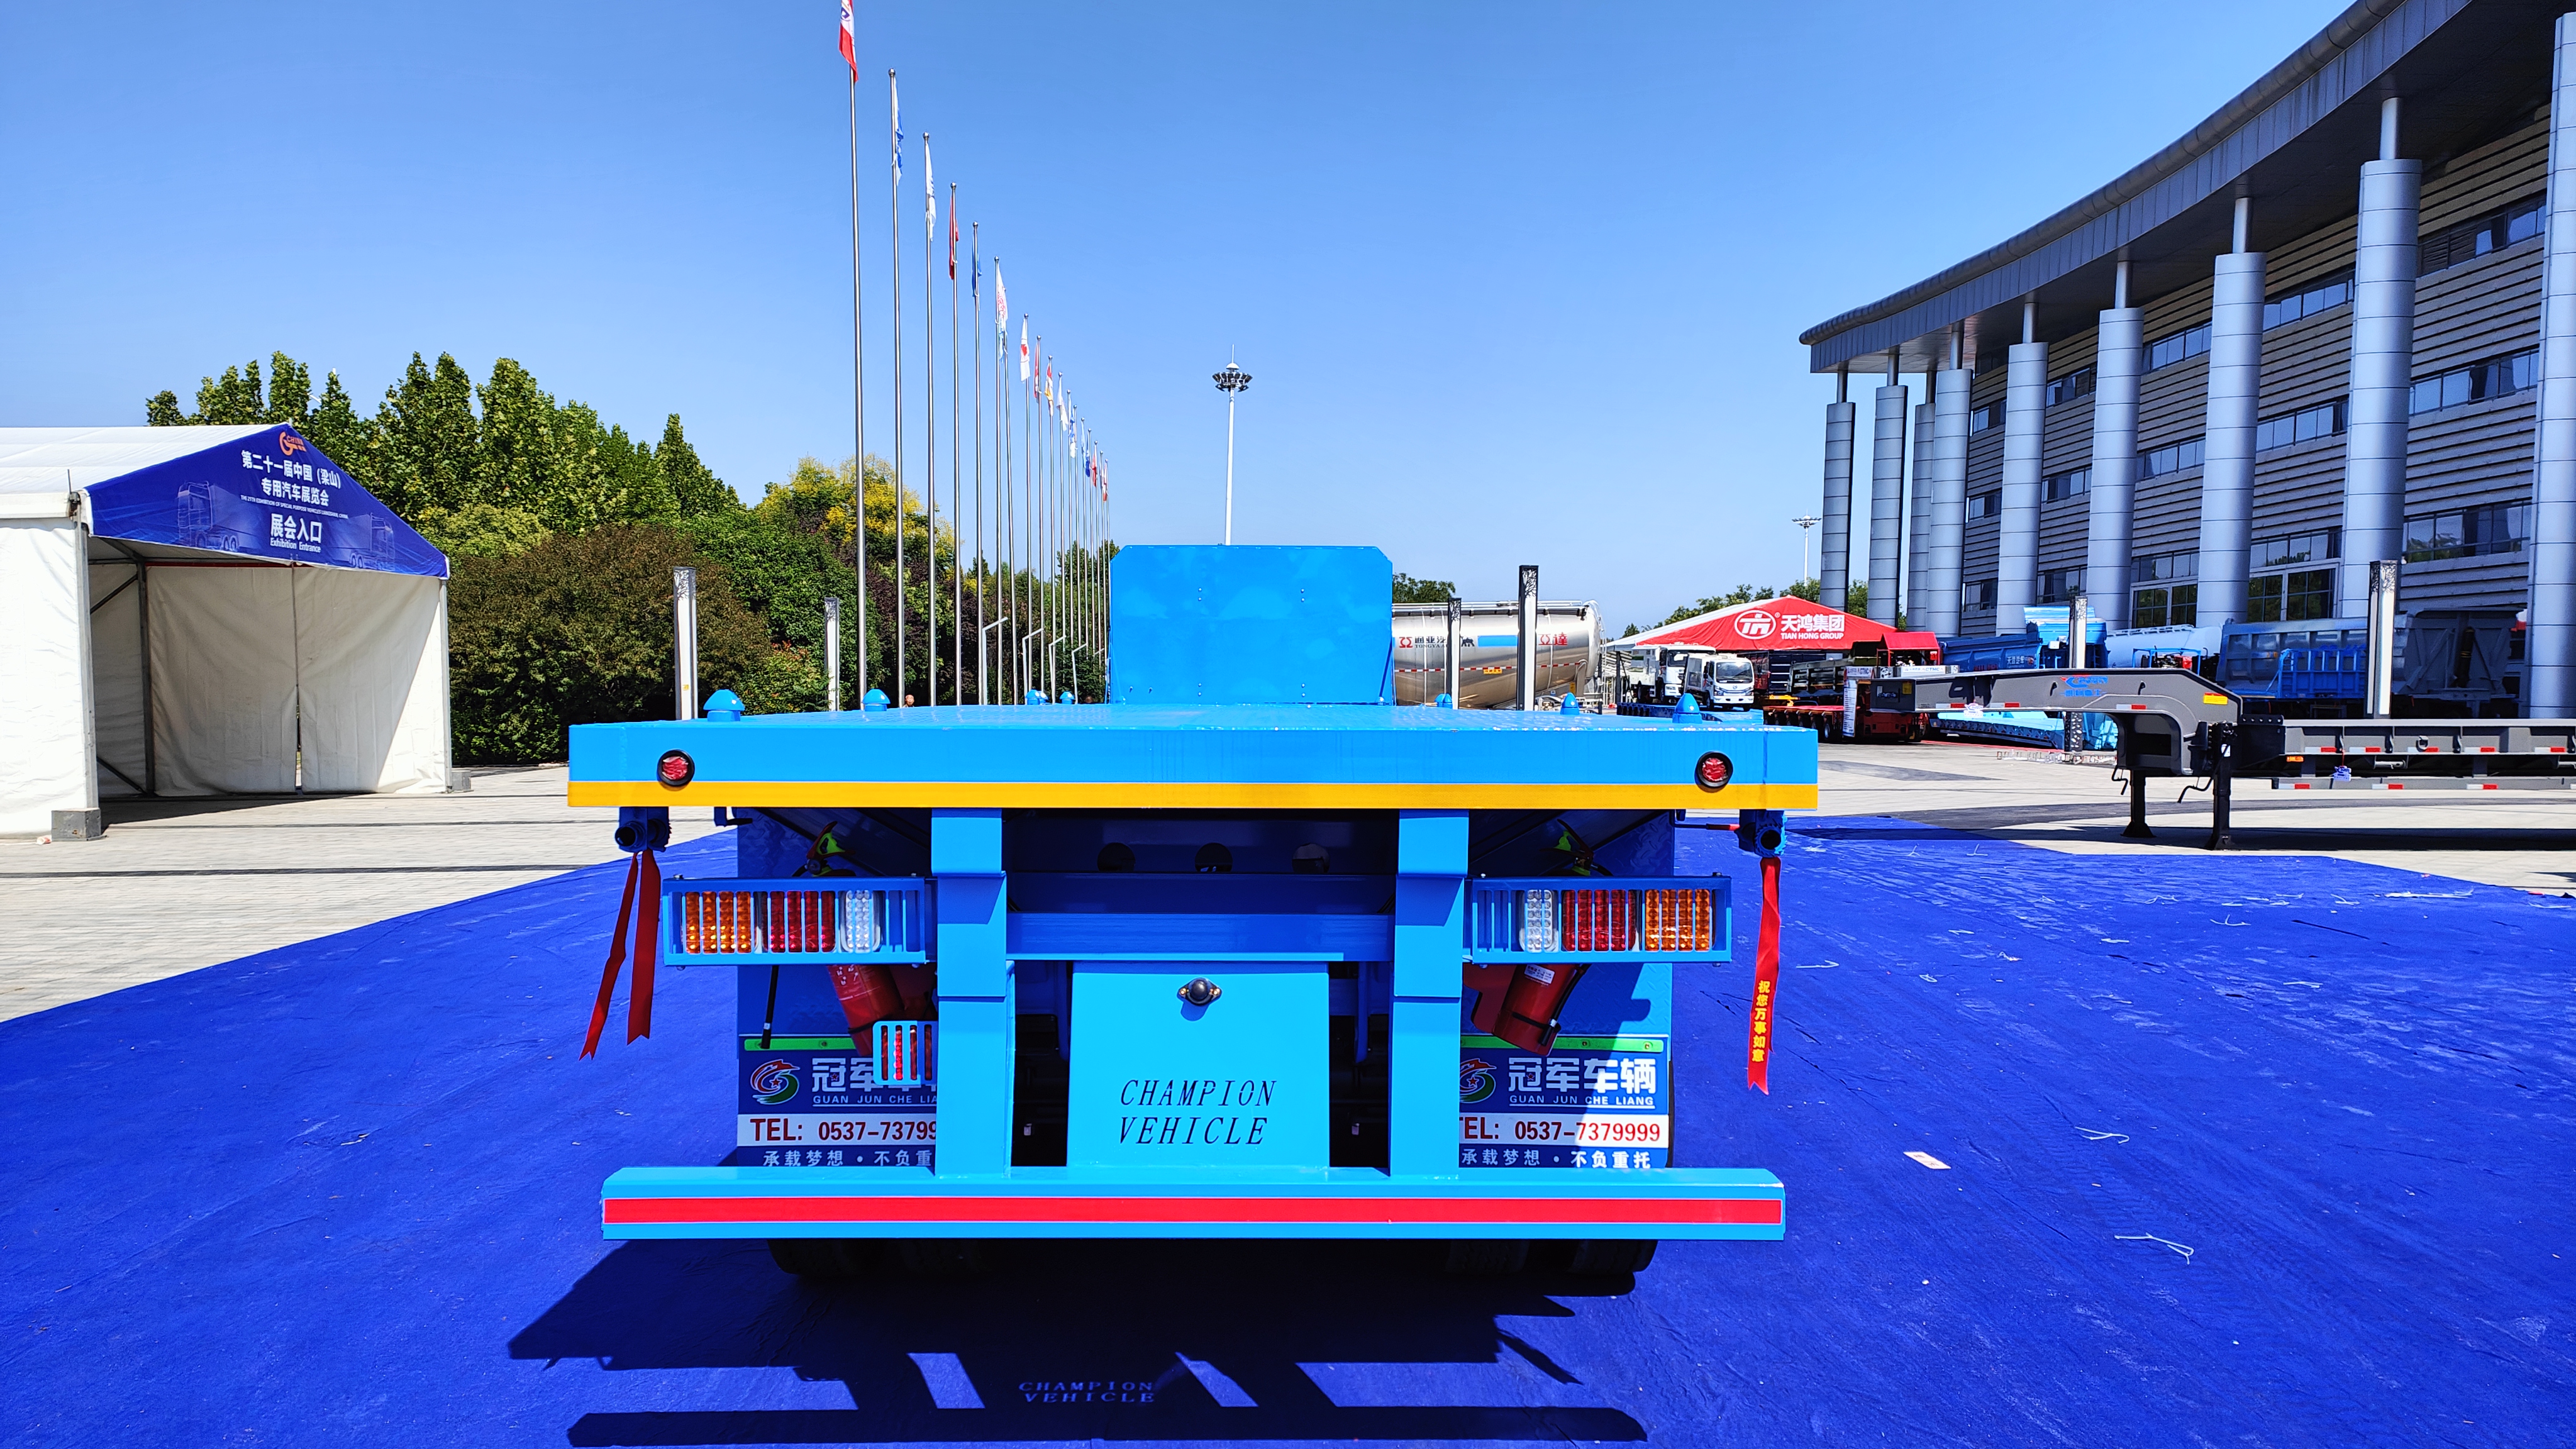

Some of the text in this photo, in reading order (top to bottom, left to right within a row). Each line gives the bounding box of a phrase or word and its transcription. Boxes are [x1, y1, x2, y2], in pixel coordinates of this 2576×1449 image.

[261, 477, 329, 507] 专用汽车展览会
[270, 513, 323, 543] 展会入口
[270, 538, 321, 553] Exhibition Entrance
[1780, 614, 1845, 632] 天鸿集团
[1752, 980, 1770, 1062] 祝您万事如意
[1508, 1057, 1656, 1094] 冠军车辆
[813, 1095, 849, 1104] GUAN
[857, 1095, 882, 1104] JUN
[889, 1095, 912, 1104] CHE
[1120, 1079, 1277, 1106] CHAMPION
[1509, 1094, 1654, 1106] GUAN JUN CHE LIANG
[750, 1118, 803, 1141] TEL:
[1119, 1116, 1268, 1145] VEHICLE
[1514, 1121, 1660, 1141] 0537-7379999
[1018, 1381, 1153, 1392] CHAMPION
[1024, 1392, 1155, 1403] VEHICLE
